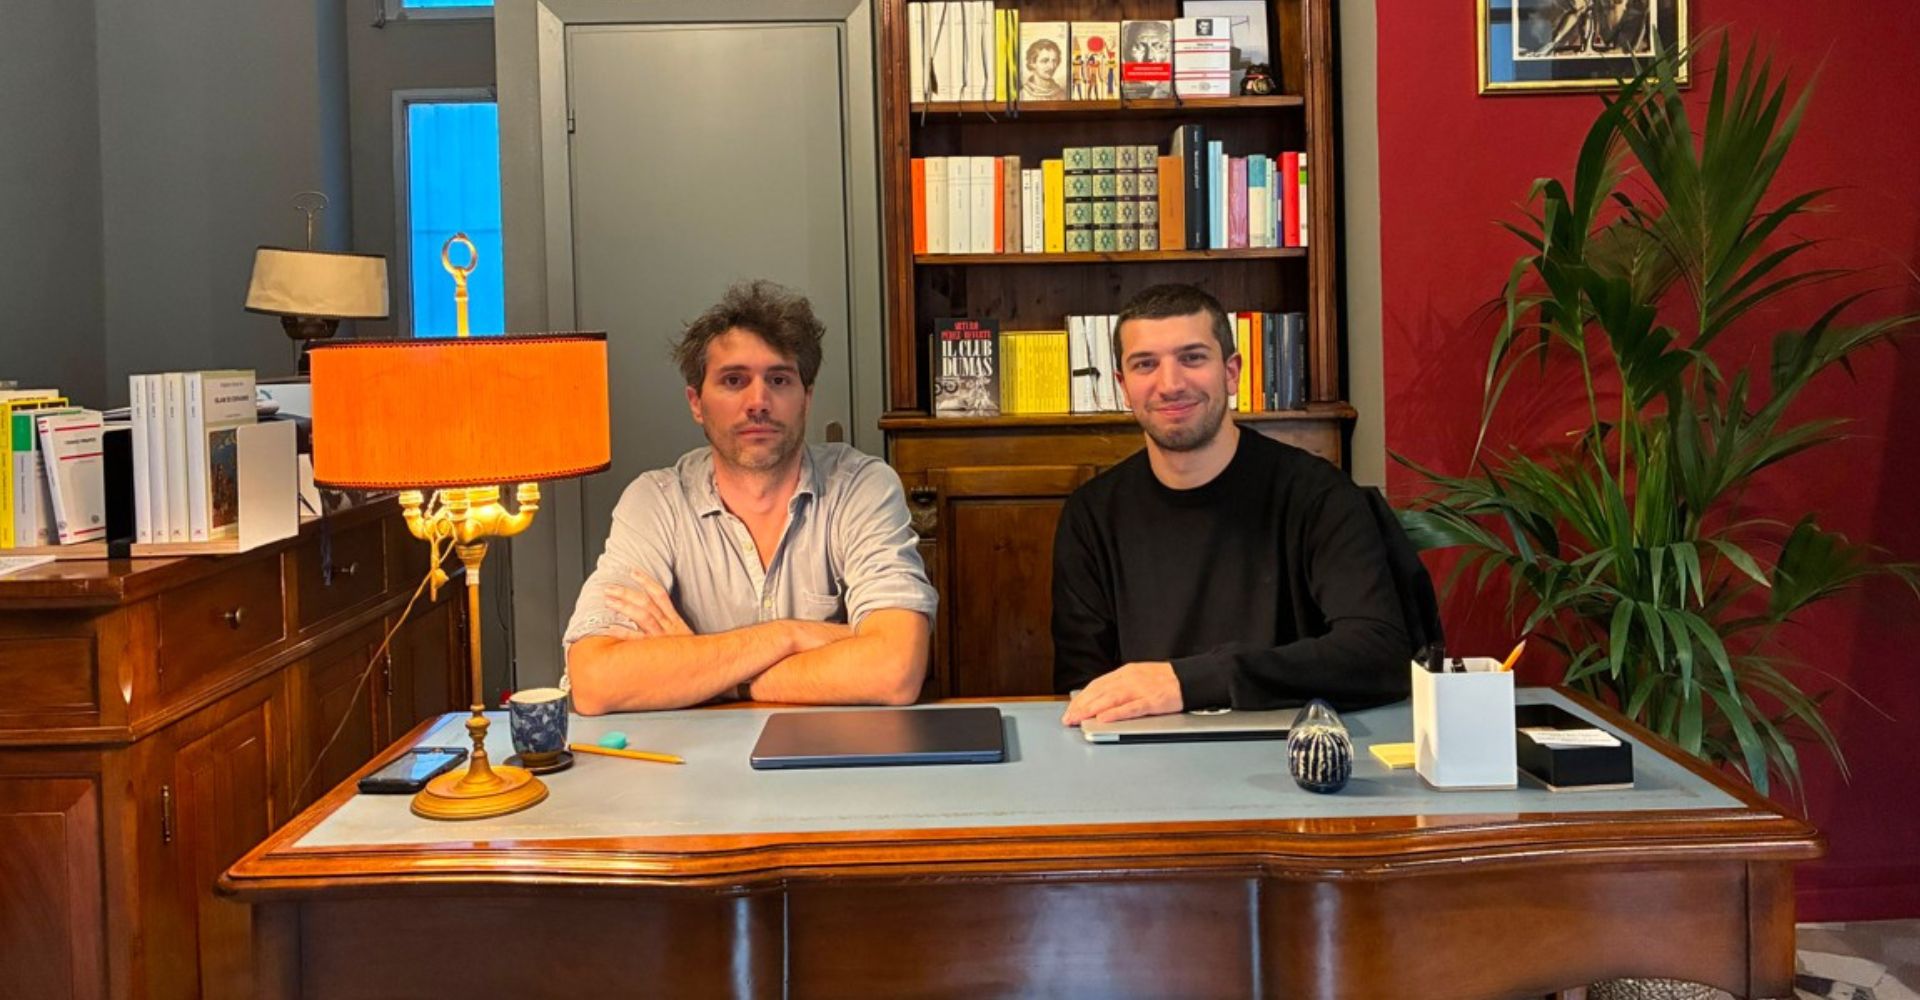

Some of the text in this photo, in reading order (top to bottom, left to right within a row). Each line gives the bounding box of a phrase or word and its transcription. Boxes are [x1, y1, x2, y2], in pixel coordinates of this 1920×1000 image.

[942, 340, 992, 356] IL CLUB
[942, 357, 993, 377] DUMAS
